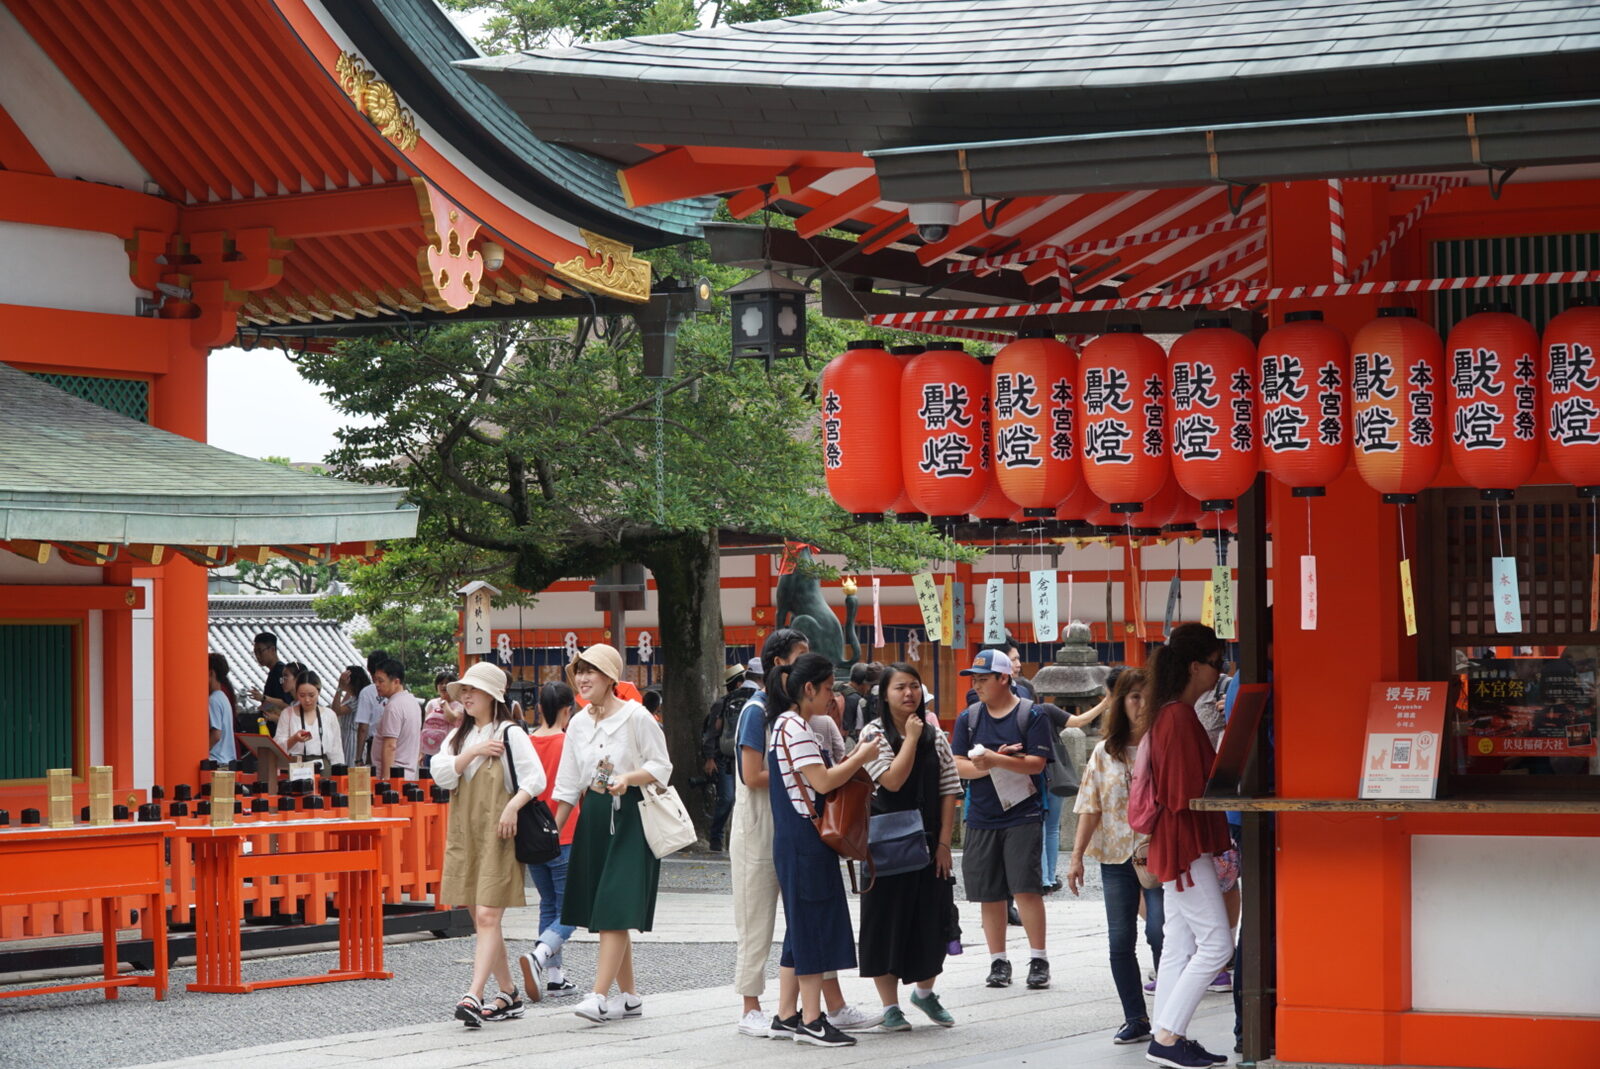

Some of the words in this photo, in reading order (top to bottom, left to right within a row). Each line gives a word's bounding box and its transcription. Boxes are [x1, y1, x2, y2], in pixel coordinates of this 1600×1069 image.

[825, 390, 841, 469] 本宮祭
[1051, 377, 1074, 460] 本宮祭
[1144, 373, 1165, 456] 本宮祭
[1231, 368, 1253, 451] 本宮祭
[1318, 360, 1343, 446] 本宮祭
[1408, 360, 1434, 446] 本宮祭
[1513, 354, 1537, 440] 本宮祭
[1500, 573, 1516, 625] 本宮祭
[1386, 686, 1431, 702] 授与所
[1475, 681, 1525, 698] 本宮祭
